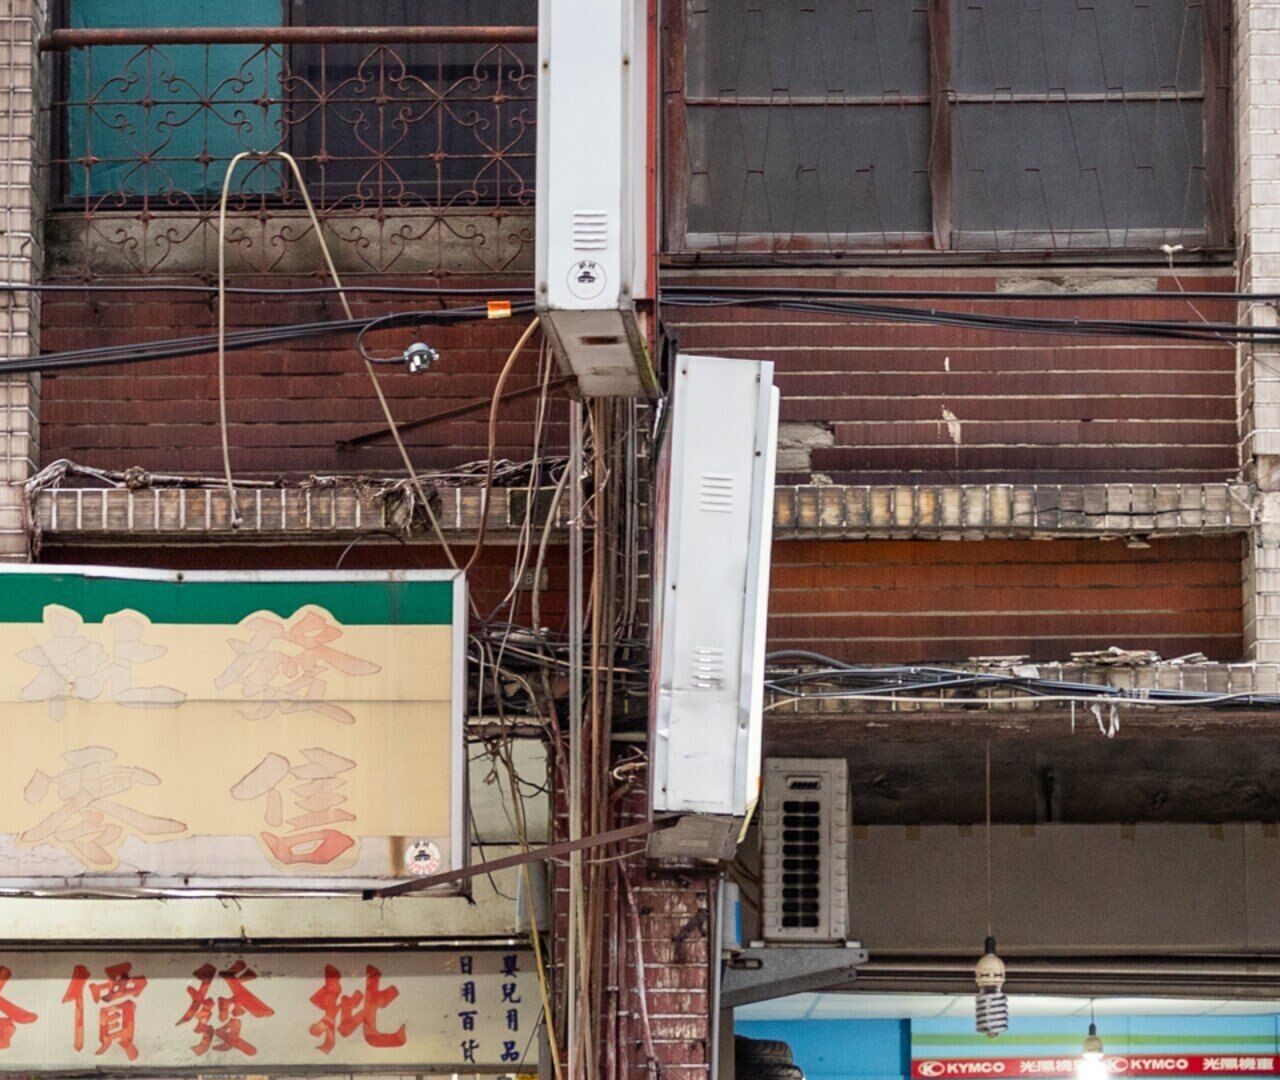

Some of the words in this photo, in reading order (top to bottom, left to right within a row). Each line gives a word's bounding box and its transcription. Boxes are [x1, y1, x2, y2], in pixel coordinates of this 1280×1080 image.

[457, 954, 481, 1064] 日用百貨
[947, 1061, 1006, 1075] KYMCO
[1131, 1058, 1188, 1071] KYMCO
